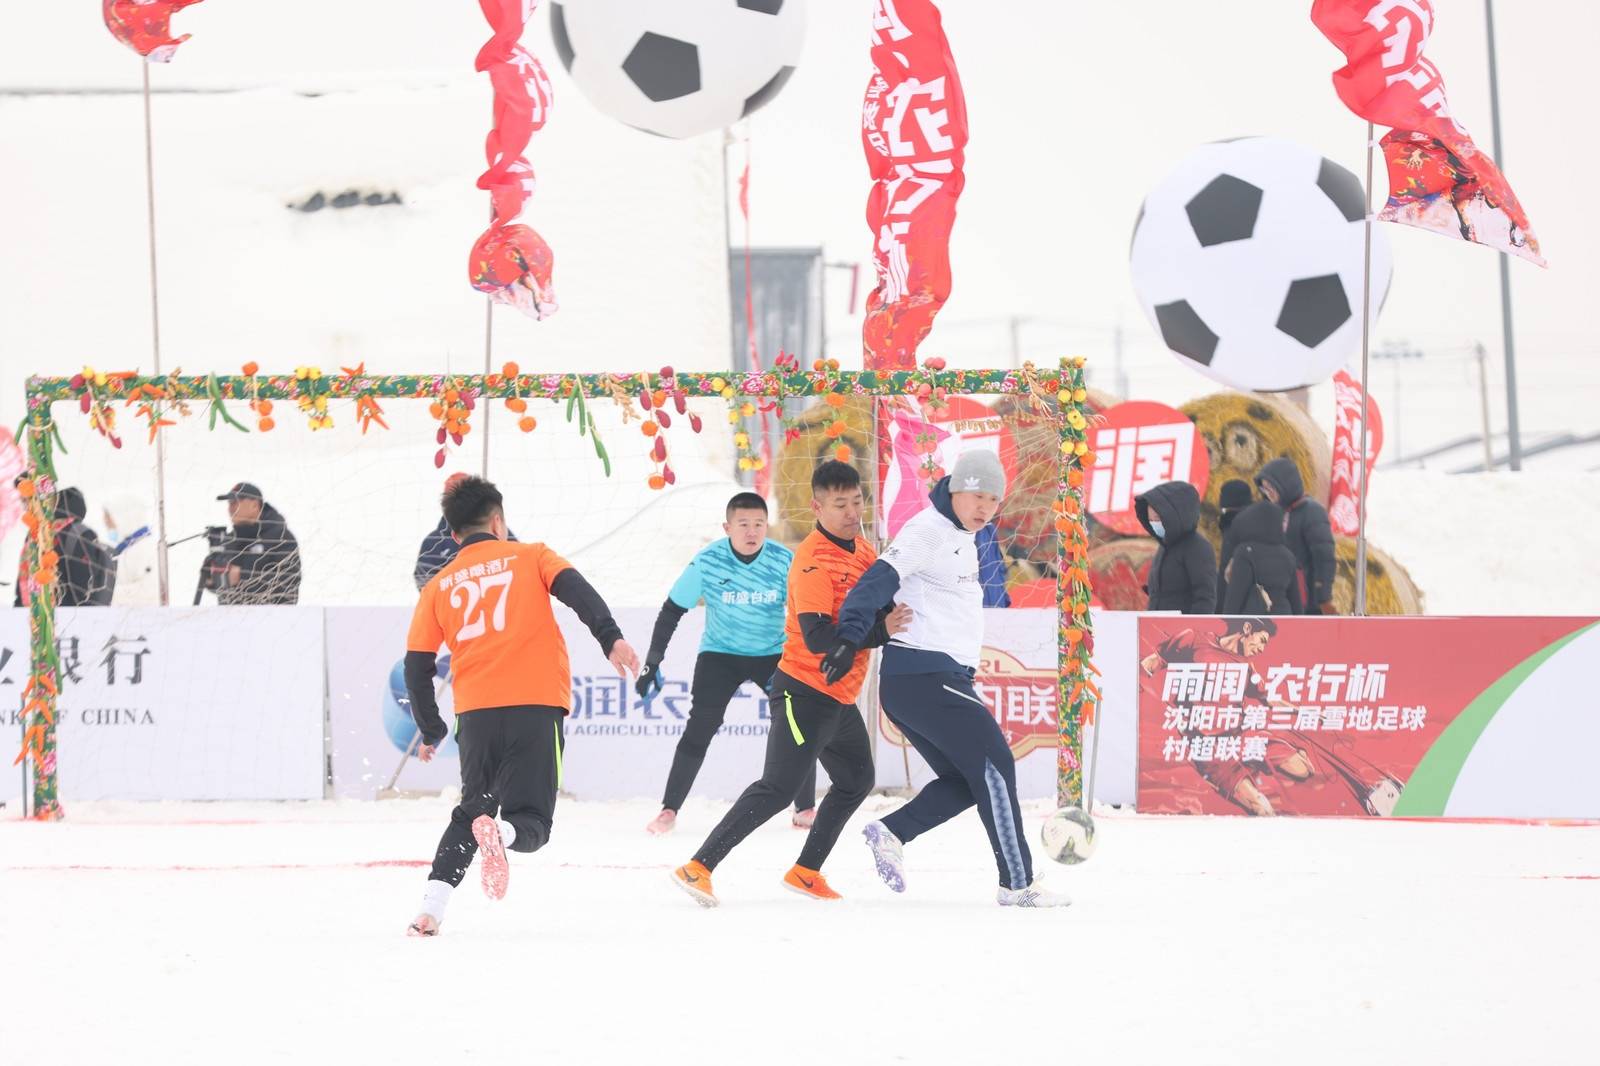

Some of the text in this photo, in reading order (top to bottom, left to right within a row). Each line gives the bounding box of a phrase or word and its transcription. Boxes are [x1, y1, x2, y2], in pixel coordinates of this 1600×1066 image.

[1088, 421, 1195, 514] 润
[450, 570, 513, 642] 27
[722, 590, 777, 604] 新盛白酒
[1161, 662, 1390, 702] 雨润·农行杯
[81, 708, 155, 725] CHINA
[1162, 705, 1428, 731] 沈阳市第三届雪地足球
[1162, 735, 1270, 762] 村超联赛
